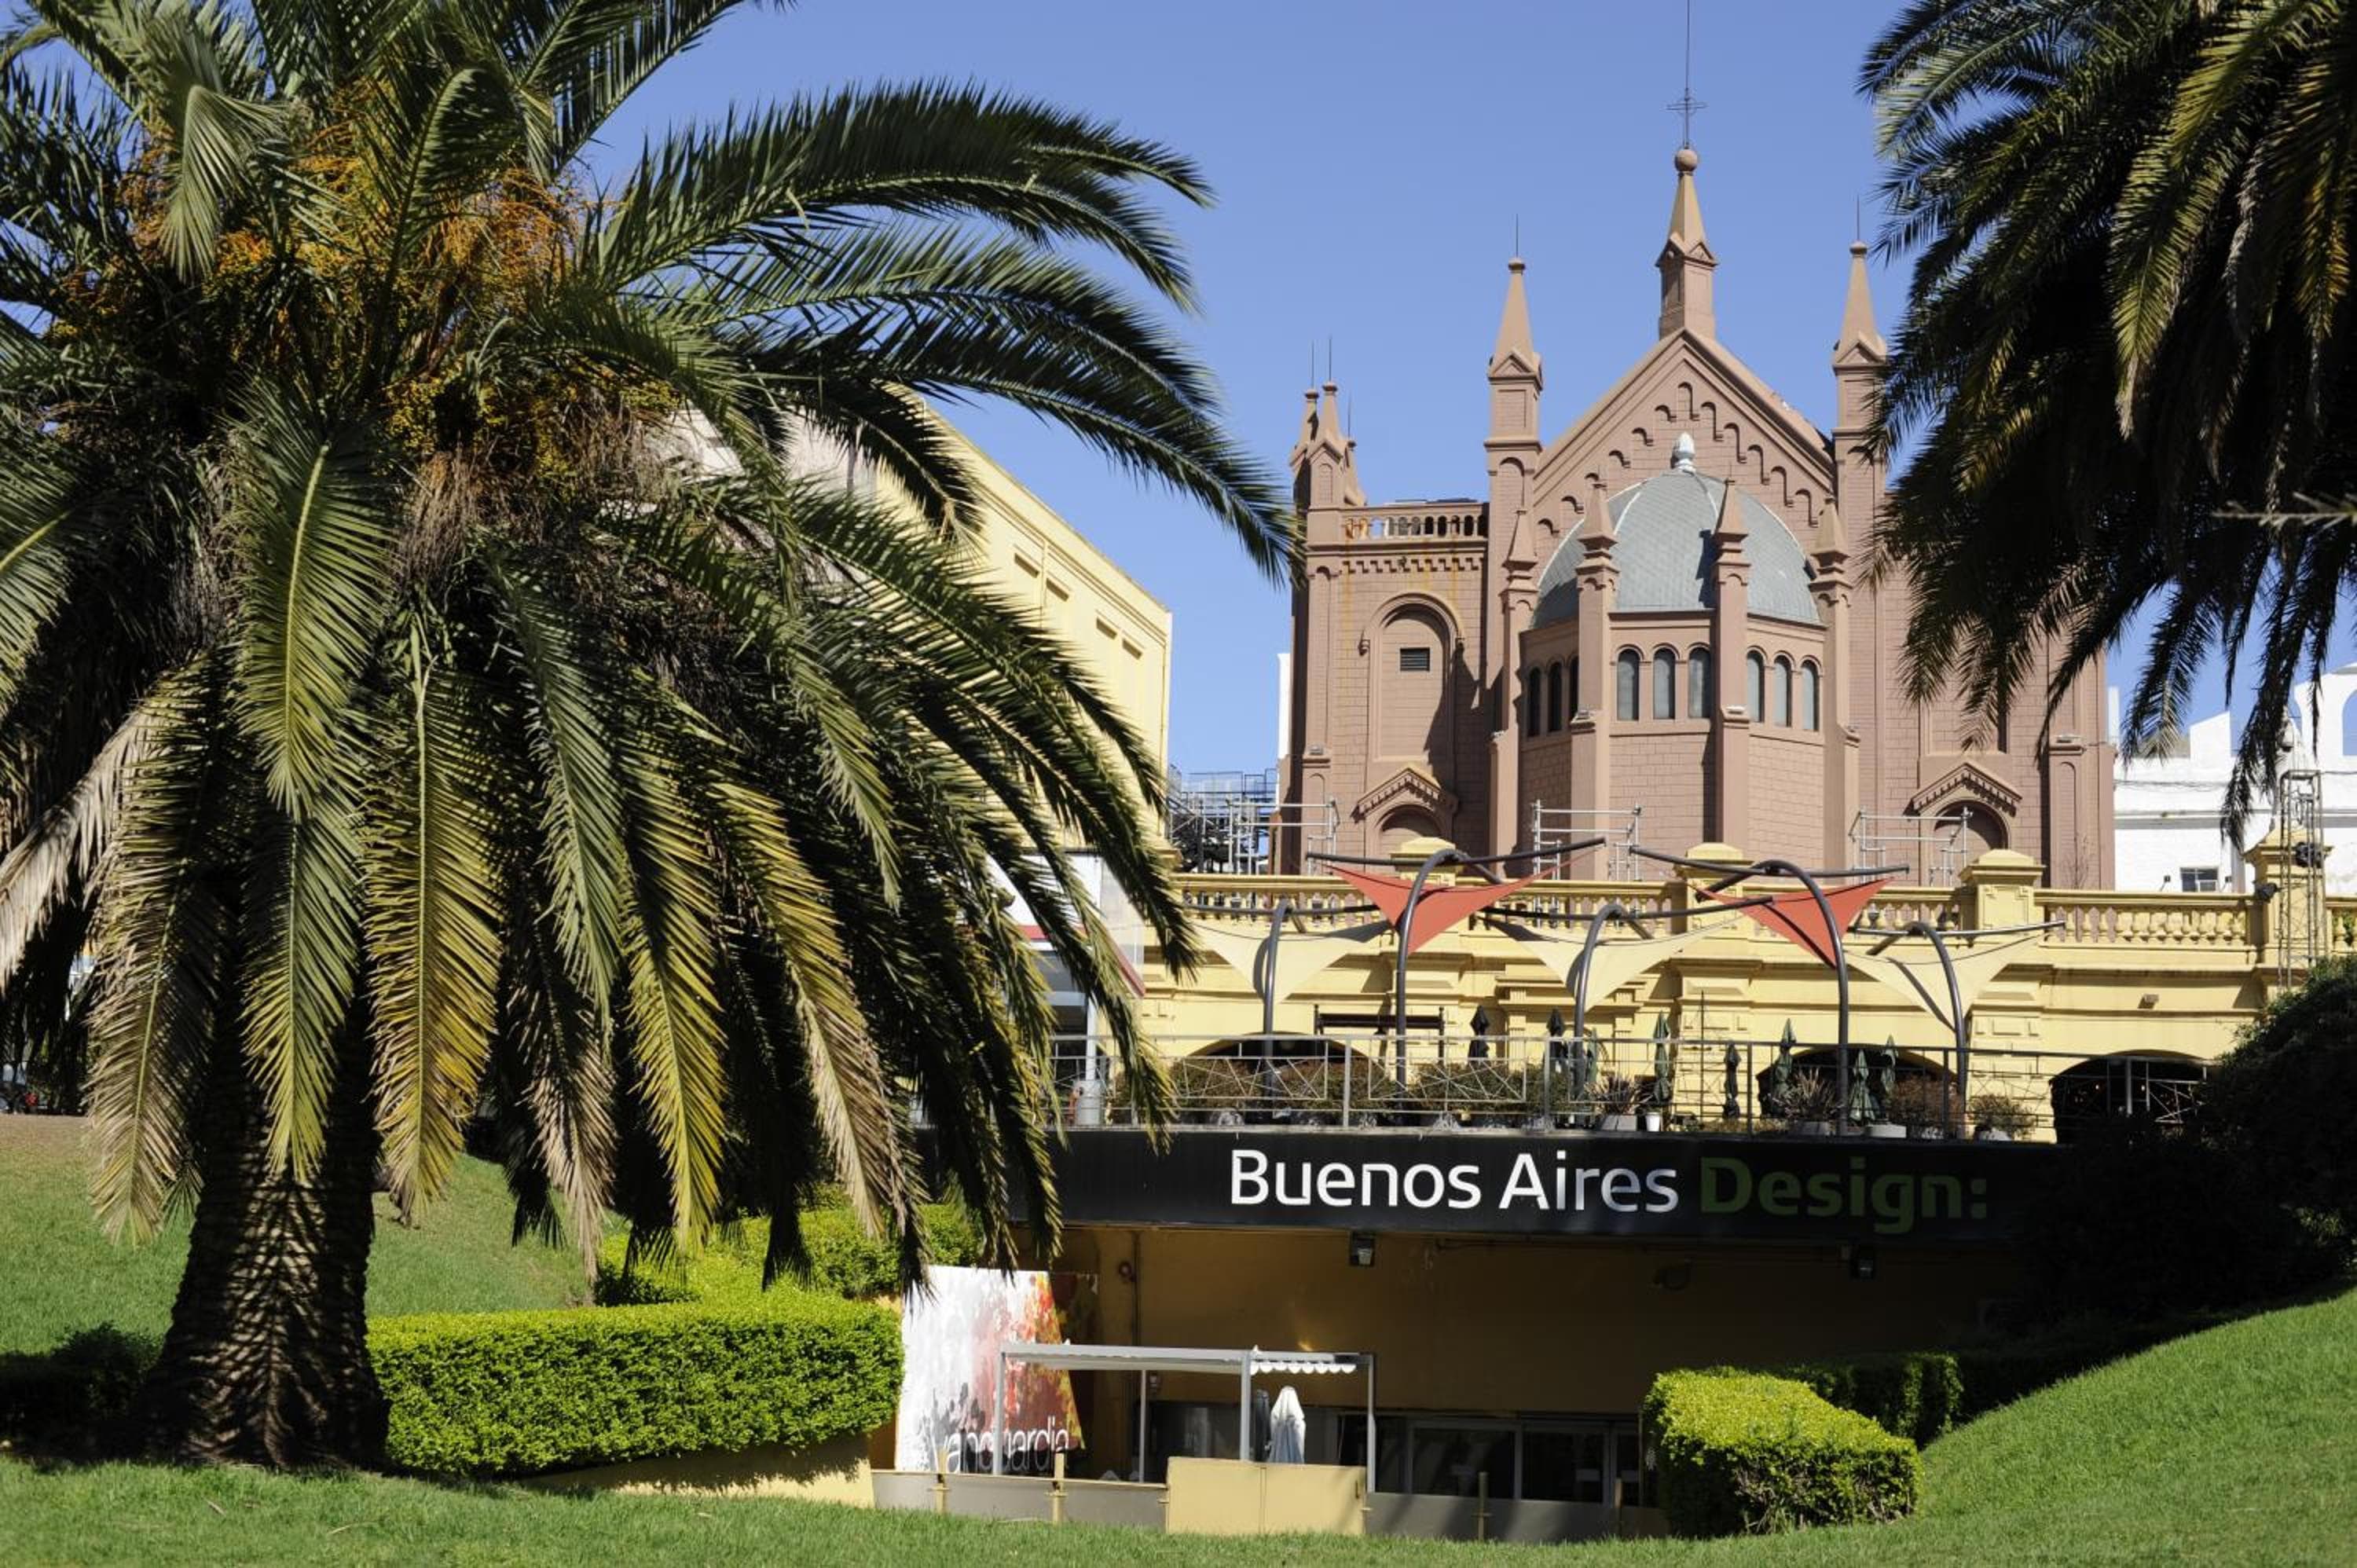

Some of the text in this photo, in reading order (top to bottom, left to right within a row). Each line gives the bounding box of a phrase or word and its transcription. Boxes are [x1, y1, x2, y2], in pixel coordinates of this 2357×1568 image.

[1231, 1150, 1987, 1233] Buenos Aires Design:
